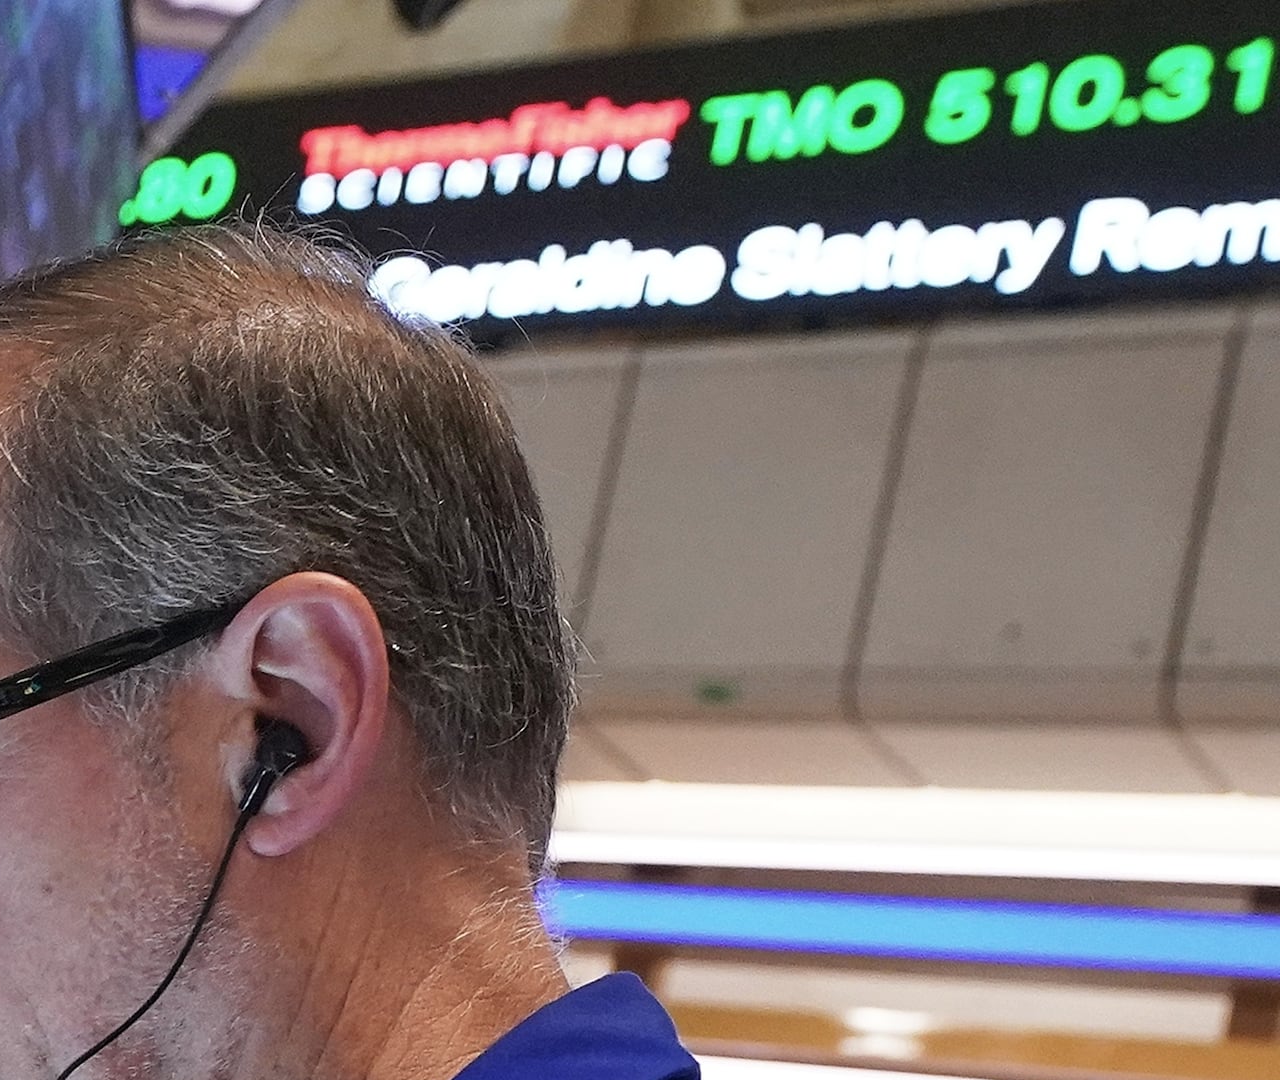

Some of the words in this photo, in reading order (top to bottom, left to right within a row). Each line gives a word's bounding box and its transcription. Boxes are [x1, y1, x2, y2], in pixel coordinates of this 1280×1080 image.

[700, 78, 905, 166] TMO
[923, 37, 1275, 145] 510.31
[297, 137, 673, 214] SCIENTIFIC
[729, 216, 1067, 301] Slattery
